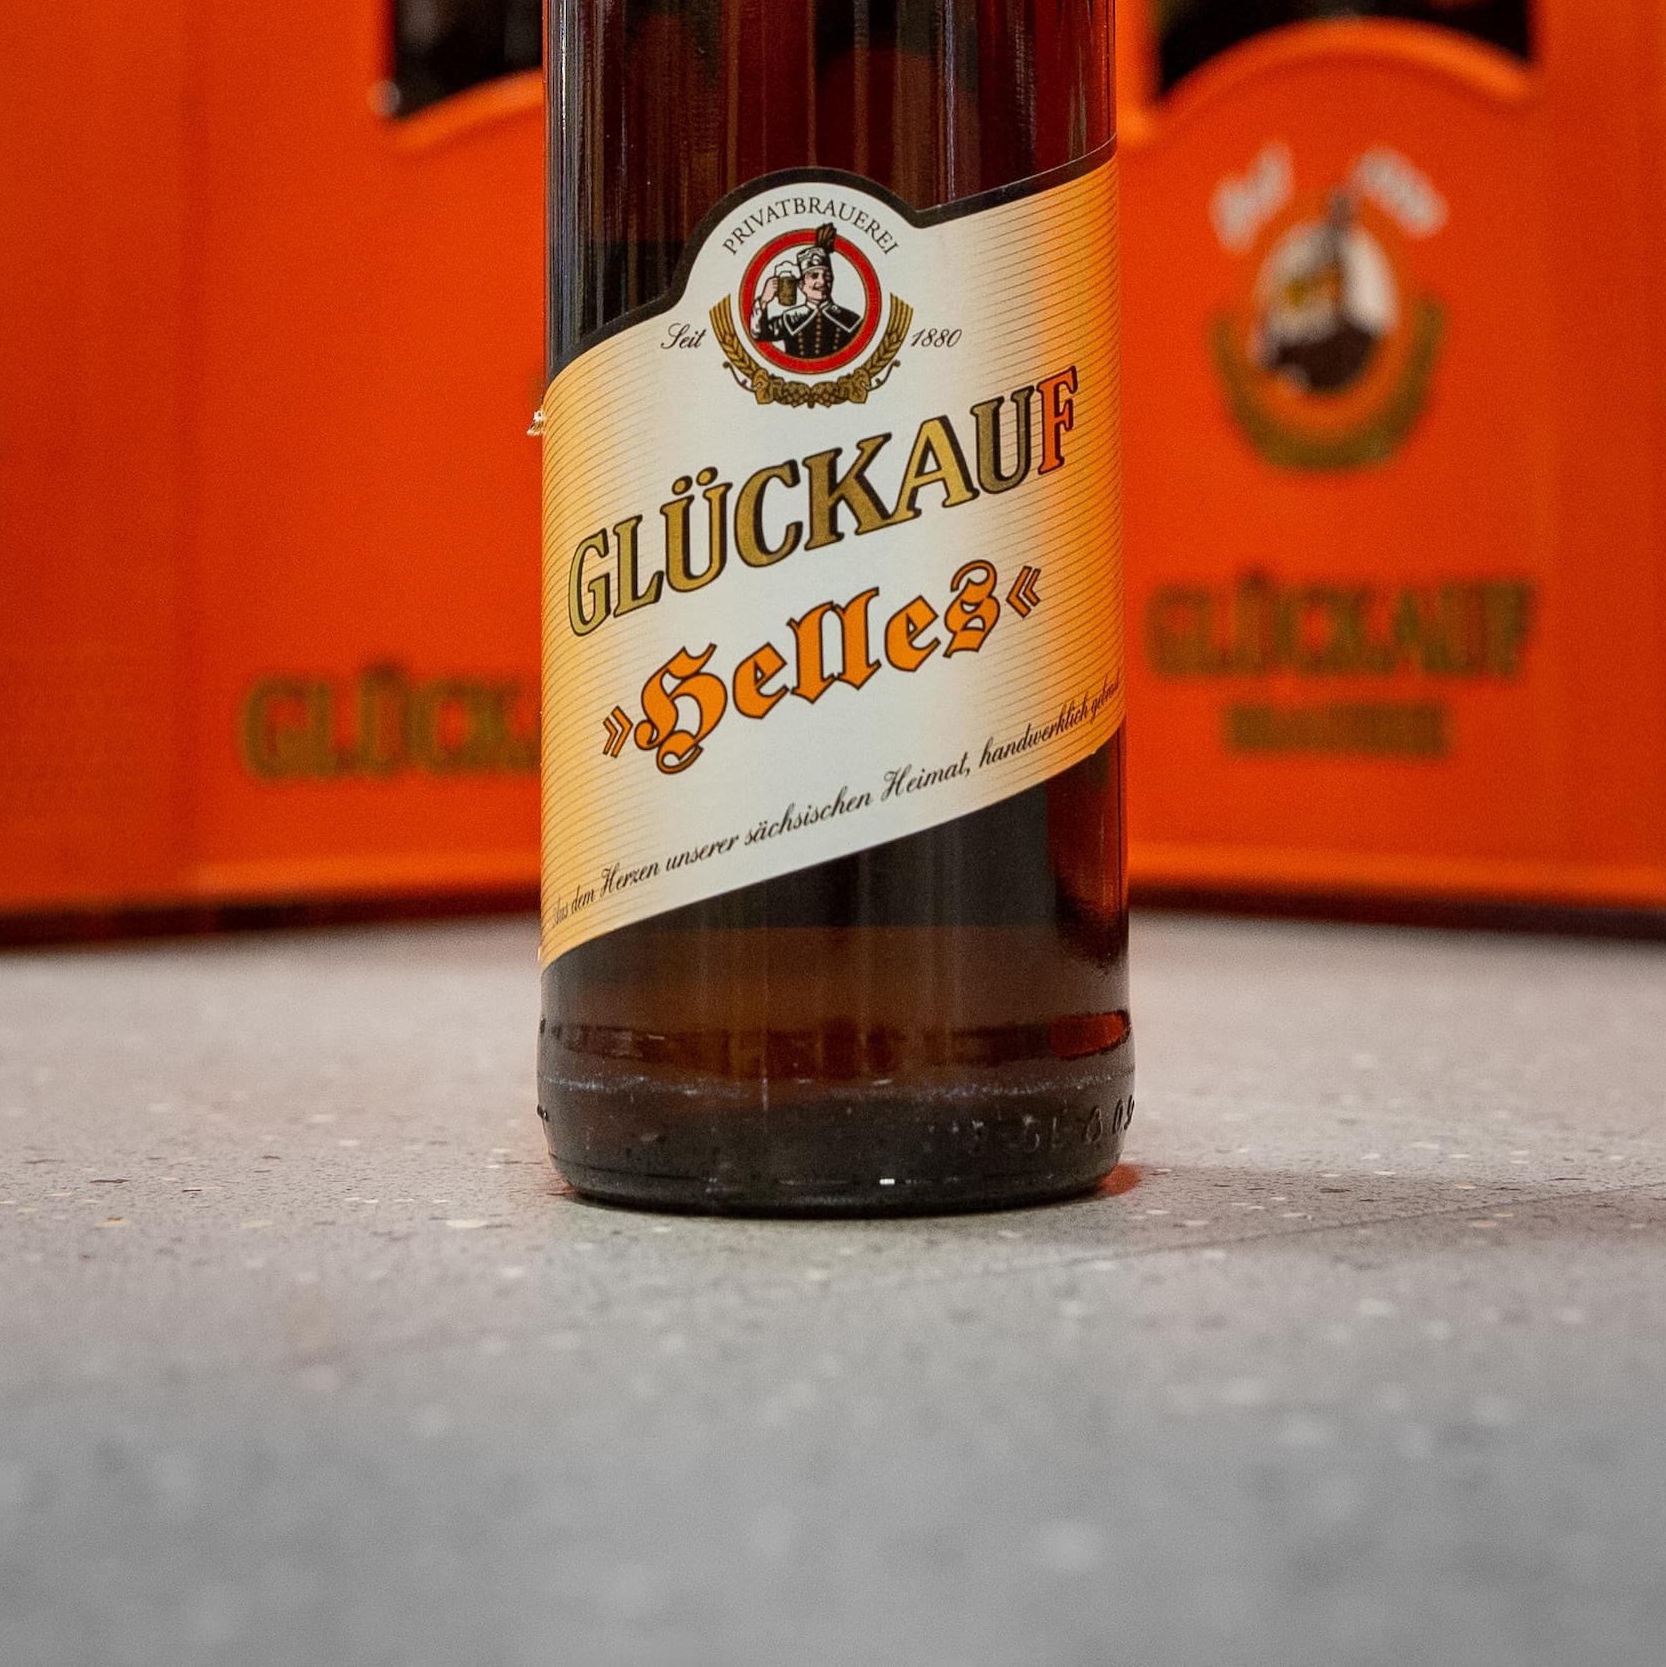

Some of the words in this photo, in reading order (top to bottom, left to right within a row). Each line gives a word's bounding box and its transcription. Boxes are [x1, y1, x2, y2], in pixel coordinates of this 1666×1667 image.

[721, 195, 900, 255] PRIVATBRAUEREI
[660, 321, 707, 350] Seit
[910, 327, 963, 348] 1880
[567, 364, 1079, 637] GLÜCKAUF
[571, 884, 595, 915] dem
[599, 862, 661, 898] Herzen
[665, 834, 740, 872] unserer
[744, 786, 873, 846] sächsischen
[880, 752, 971, 802] Heimat,
[978, 690, 1089, 770] handwerklich
